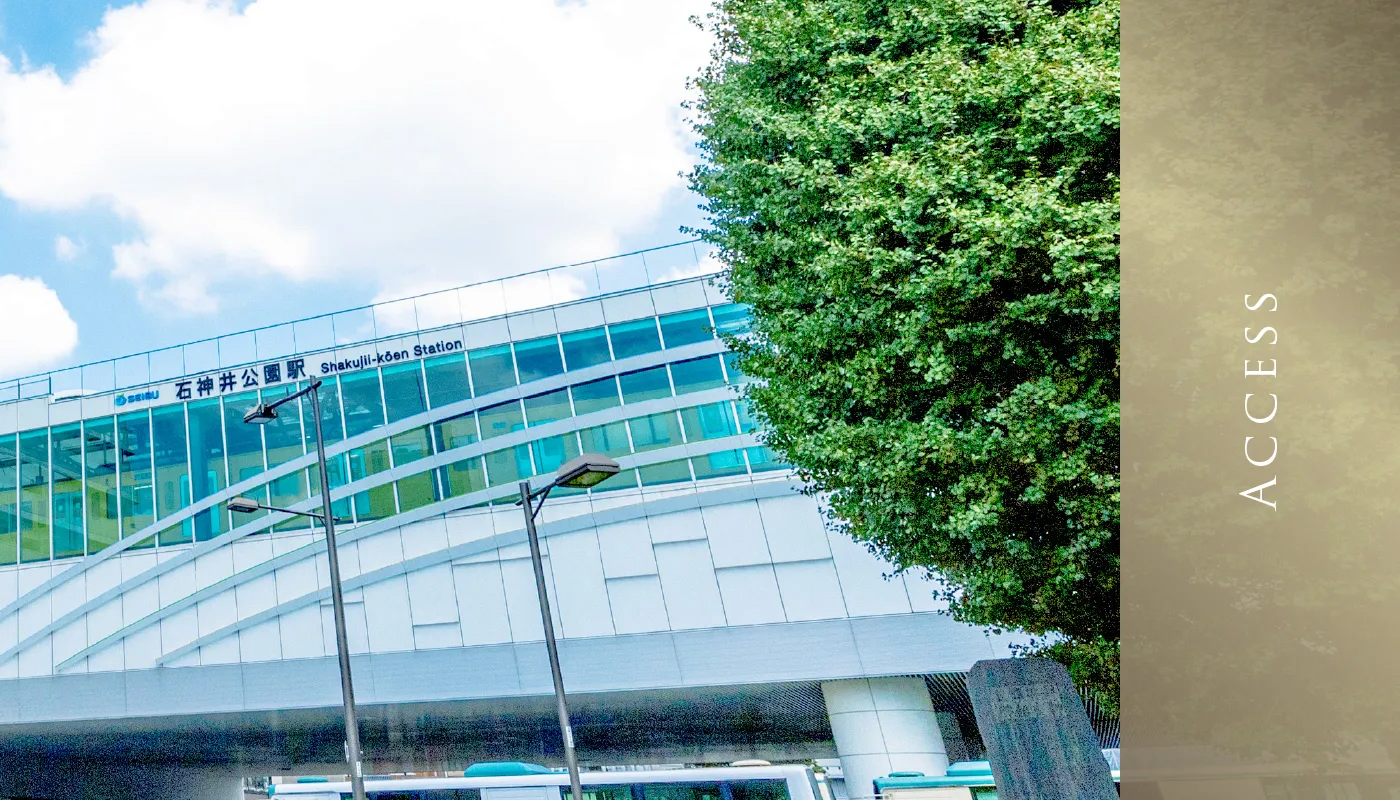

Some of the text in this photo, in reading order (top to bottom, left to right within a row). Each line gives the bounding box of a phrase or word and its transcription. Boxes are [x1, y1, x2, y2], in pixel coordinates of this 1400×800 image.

[321, 339, 463, 374] Shakujii-kōen Station
[127, 390, 159, 403] SEIBU
[175, 358, 306, 400] 石神井公園駅
